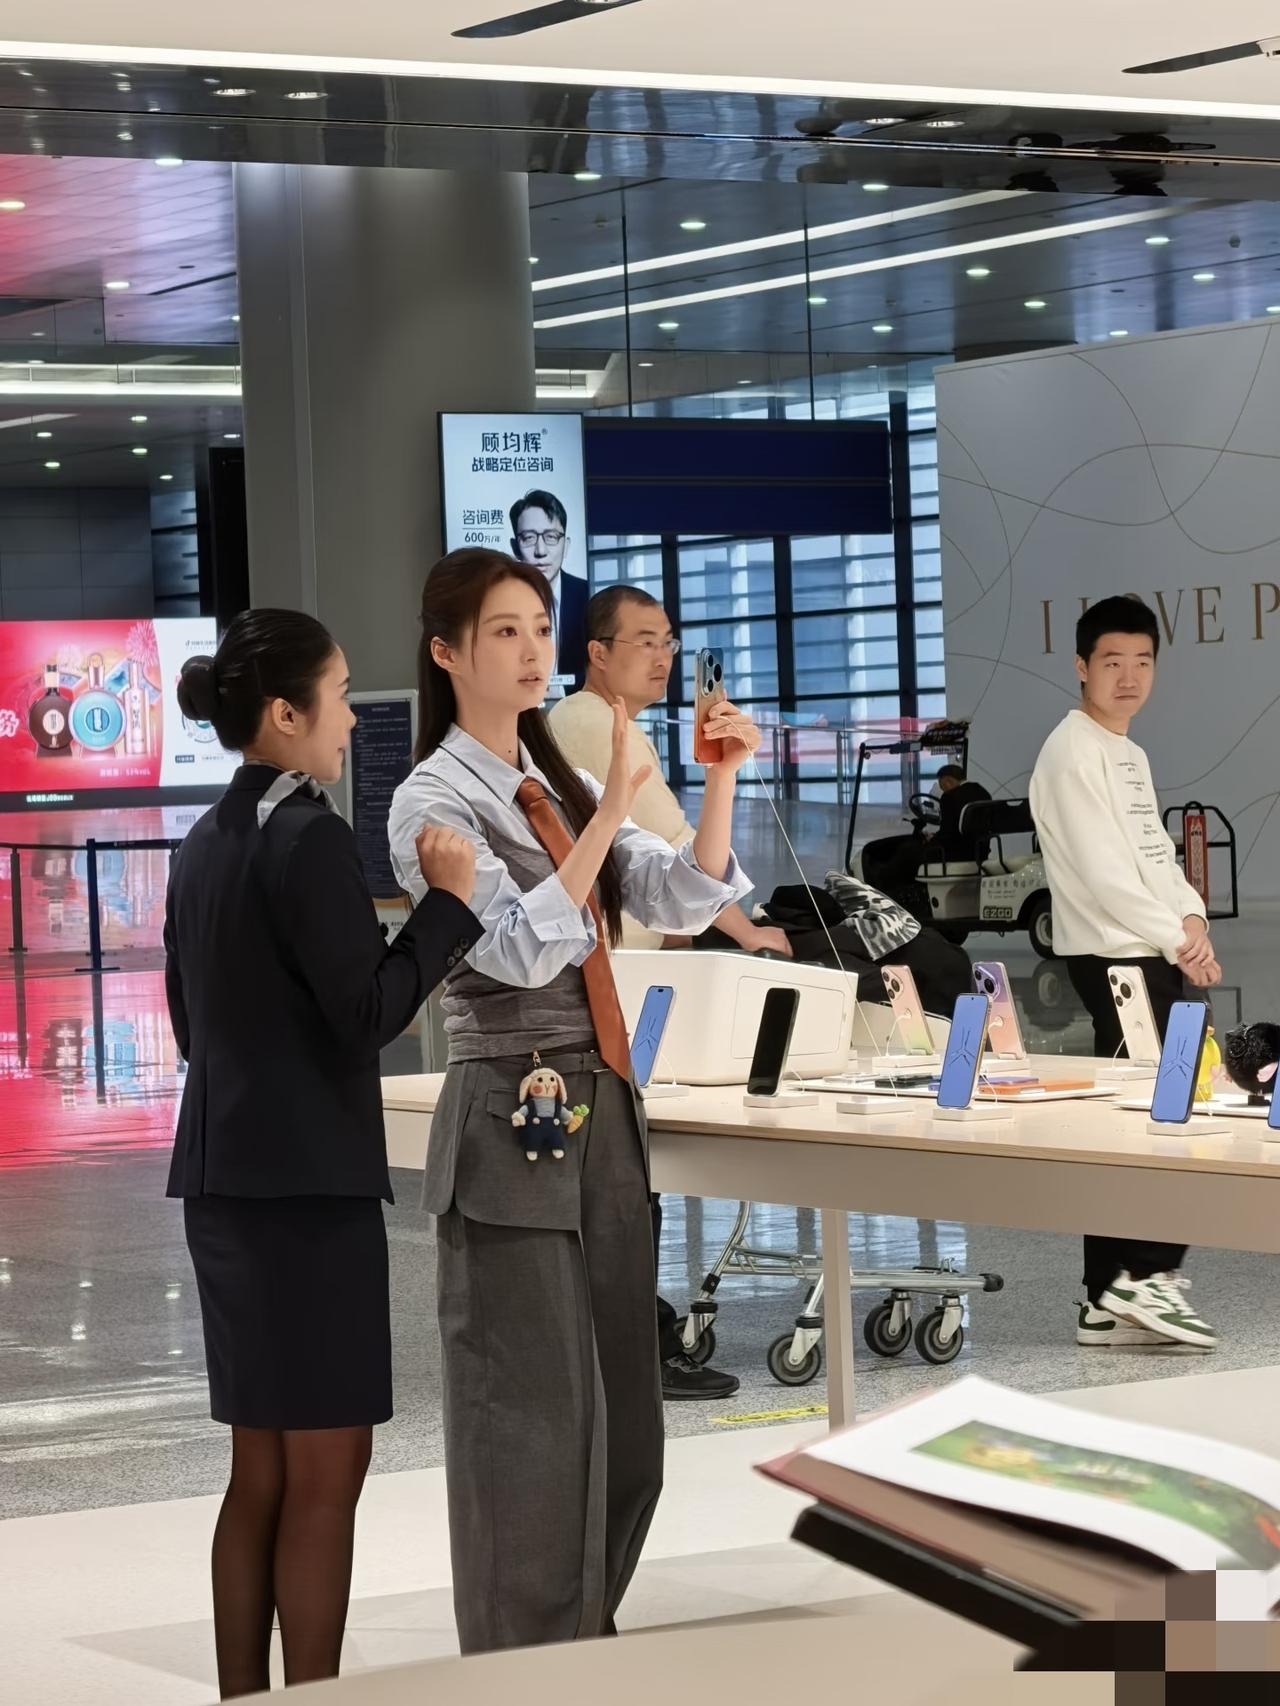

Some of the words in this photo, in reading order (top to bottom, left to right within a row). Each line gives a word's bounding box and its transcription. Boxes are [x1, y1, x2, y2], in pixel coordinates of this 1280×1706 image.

[481, 432, 542, 453] 顾均辉
[471, 457, 554, 473] 战略定位咨询
[462, 509, 504, 525] 咨询费
[1078, 586, 1225, 647] VE
